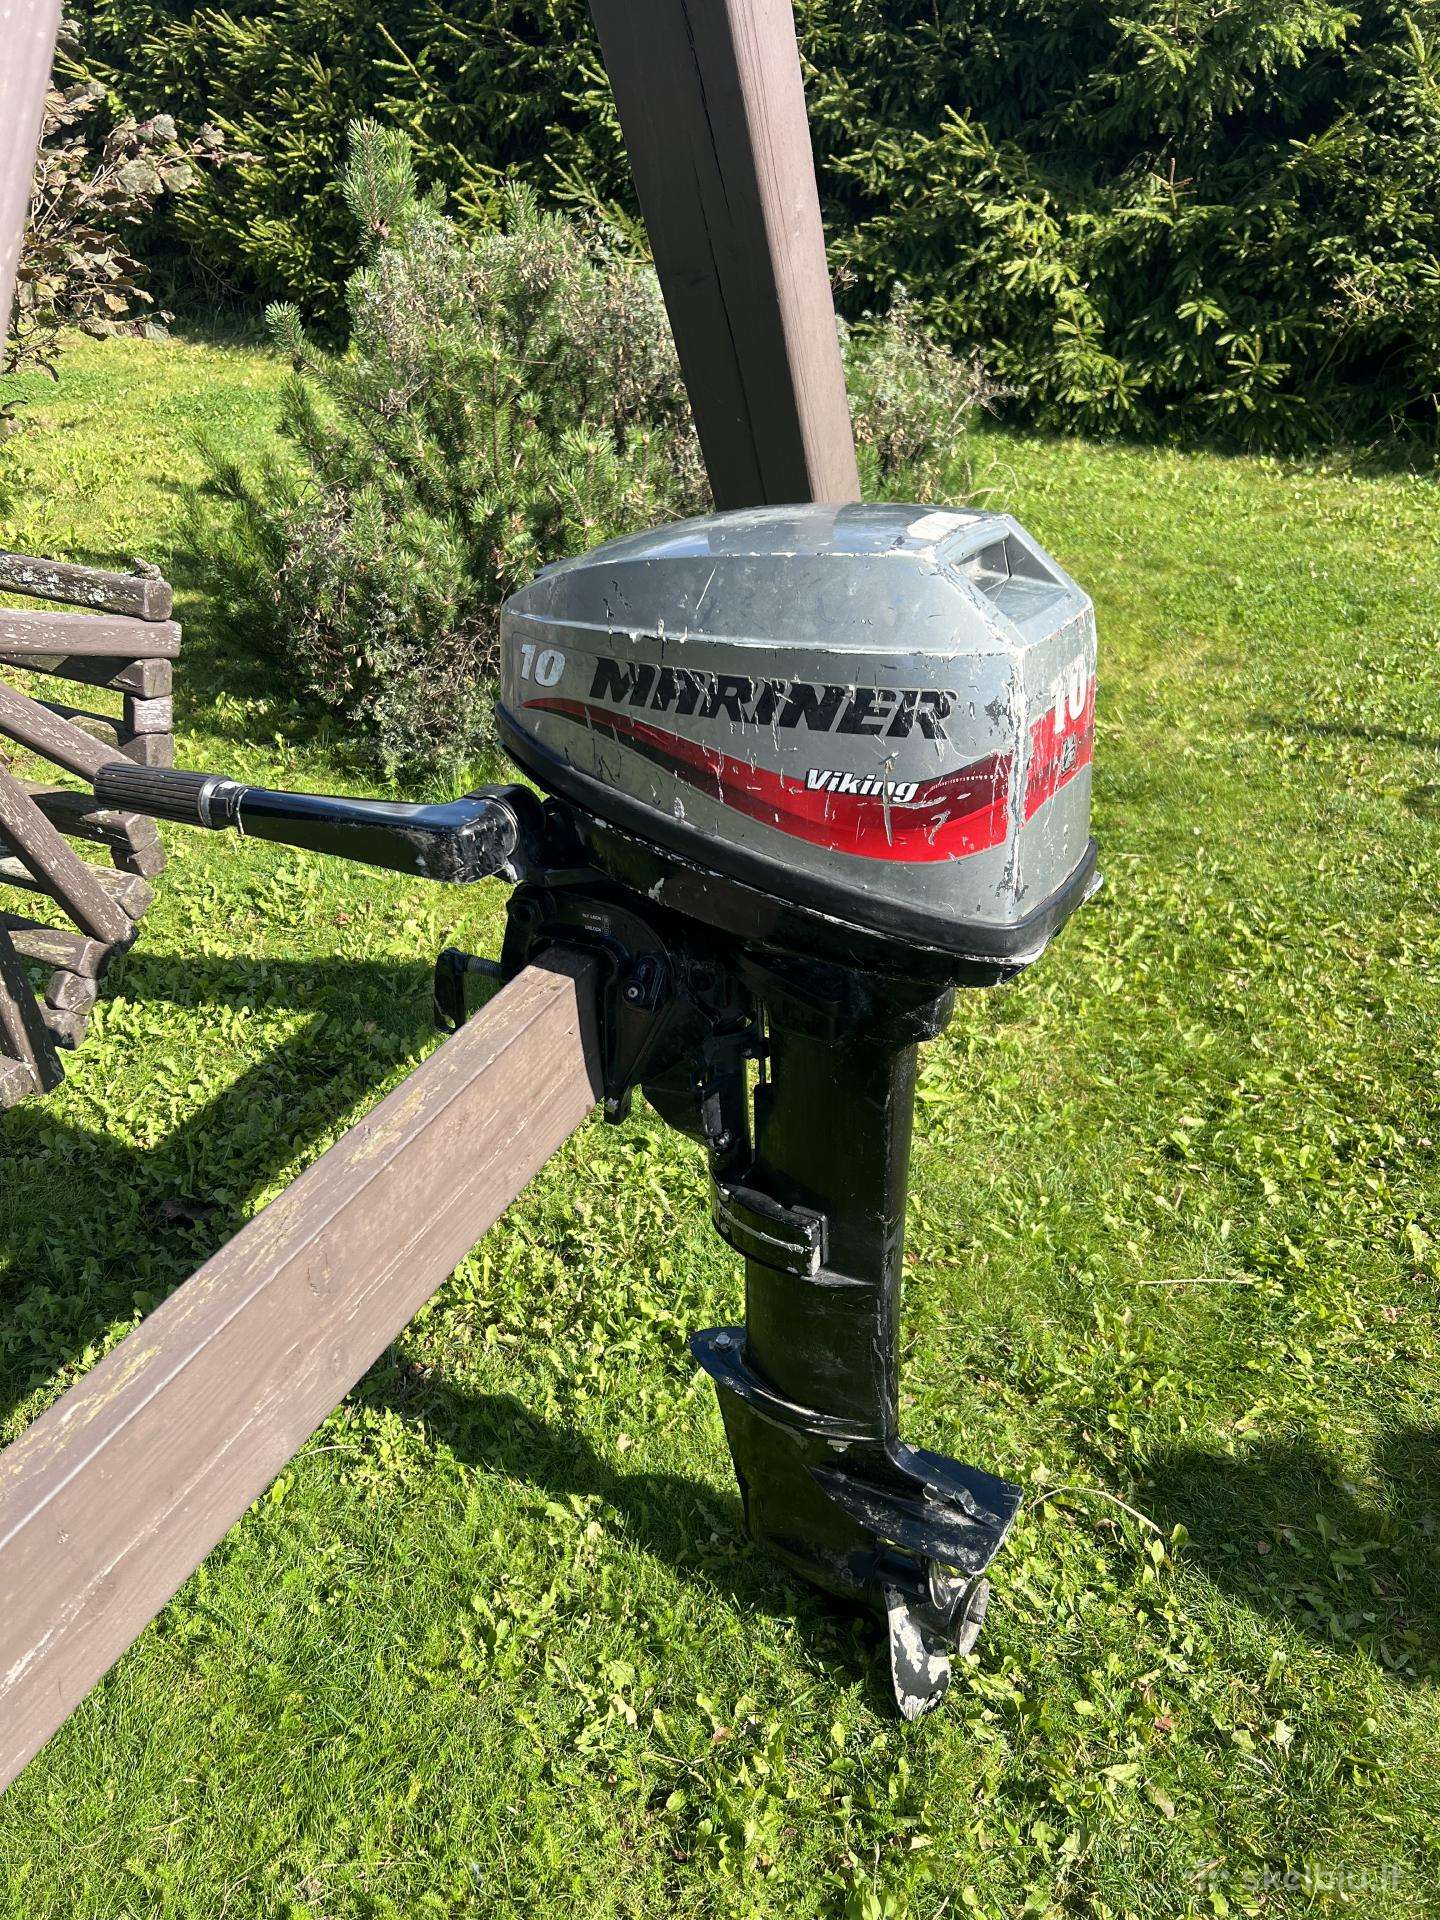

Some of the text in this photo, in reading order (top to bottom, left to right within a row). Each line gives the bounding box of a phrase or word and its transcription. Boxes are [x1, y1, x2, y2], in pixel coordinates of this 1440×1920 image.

[520, 643, 566, 687] 10
[1049, 653, 1087, 735] 10
[589, 656, 957, 740] MARINER
[806, 768, 920, 803] Viking
